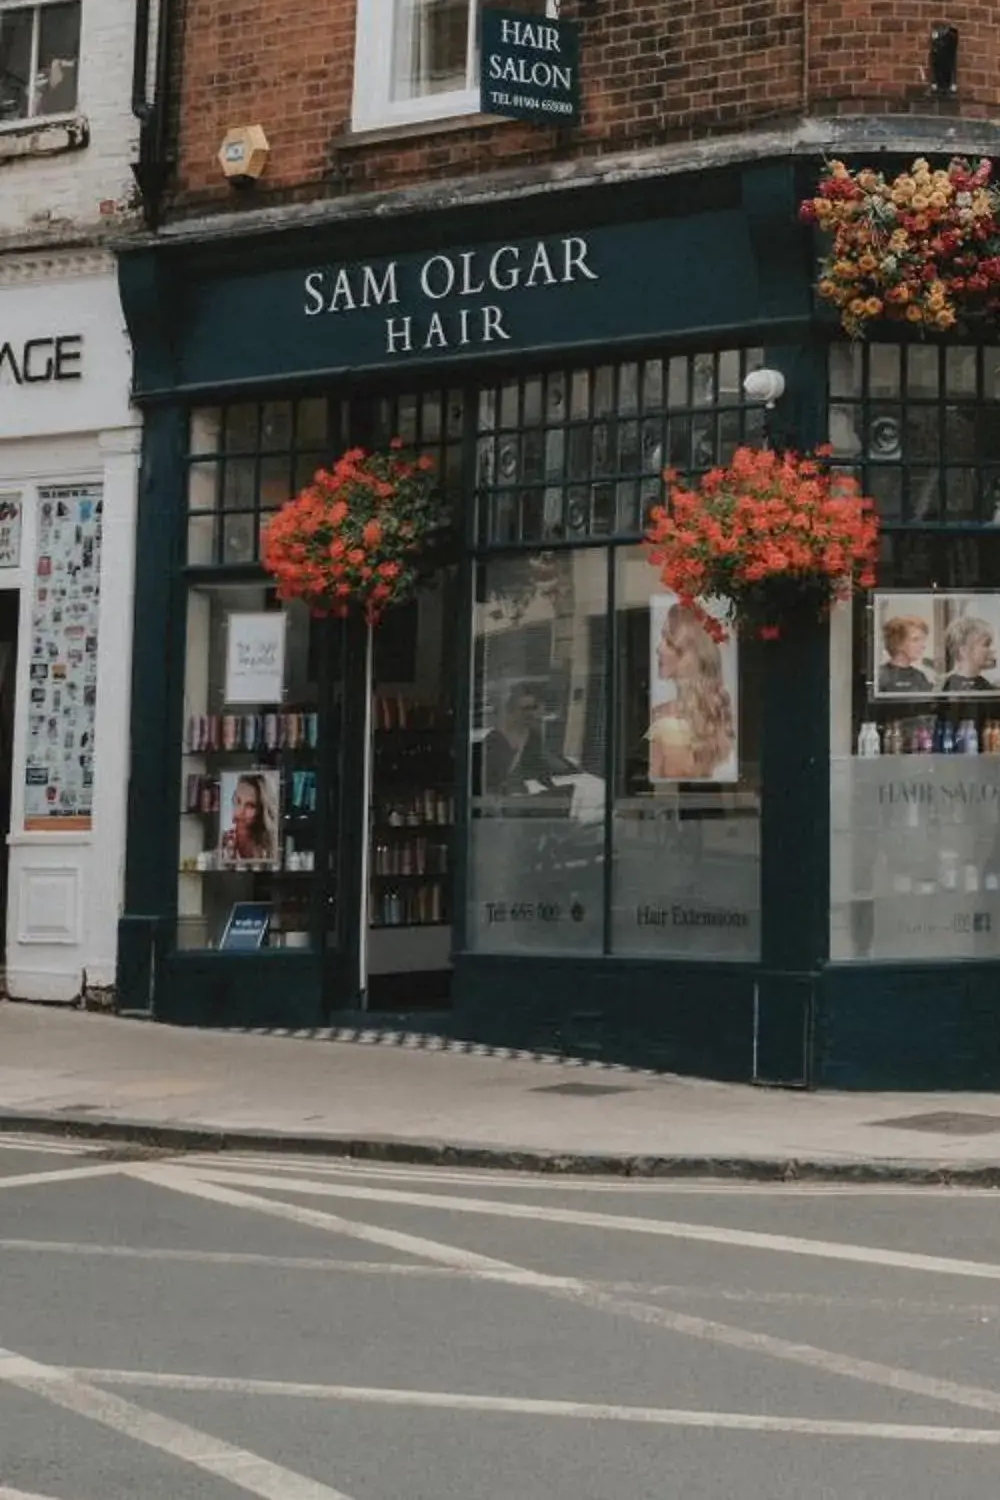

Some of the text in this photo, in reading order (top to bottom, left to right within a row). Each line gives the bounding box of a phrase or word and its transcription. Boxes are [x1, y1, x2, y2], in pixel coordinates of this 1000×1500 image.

[501, 19, 561, 53] HAIR
[489, 54, 573, 90] SALON
[490, 92, 512, 105] TEL
[304, 237, 599, 315] SAM OLGAR
[386, 305, 512, 353] HAIR
[637, 905, 749, 928] Hair Extensions
